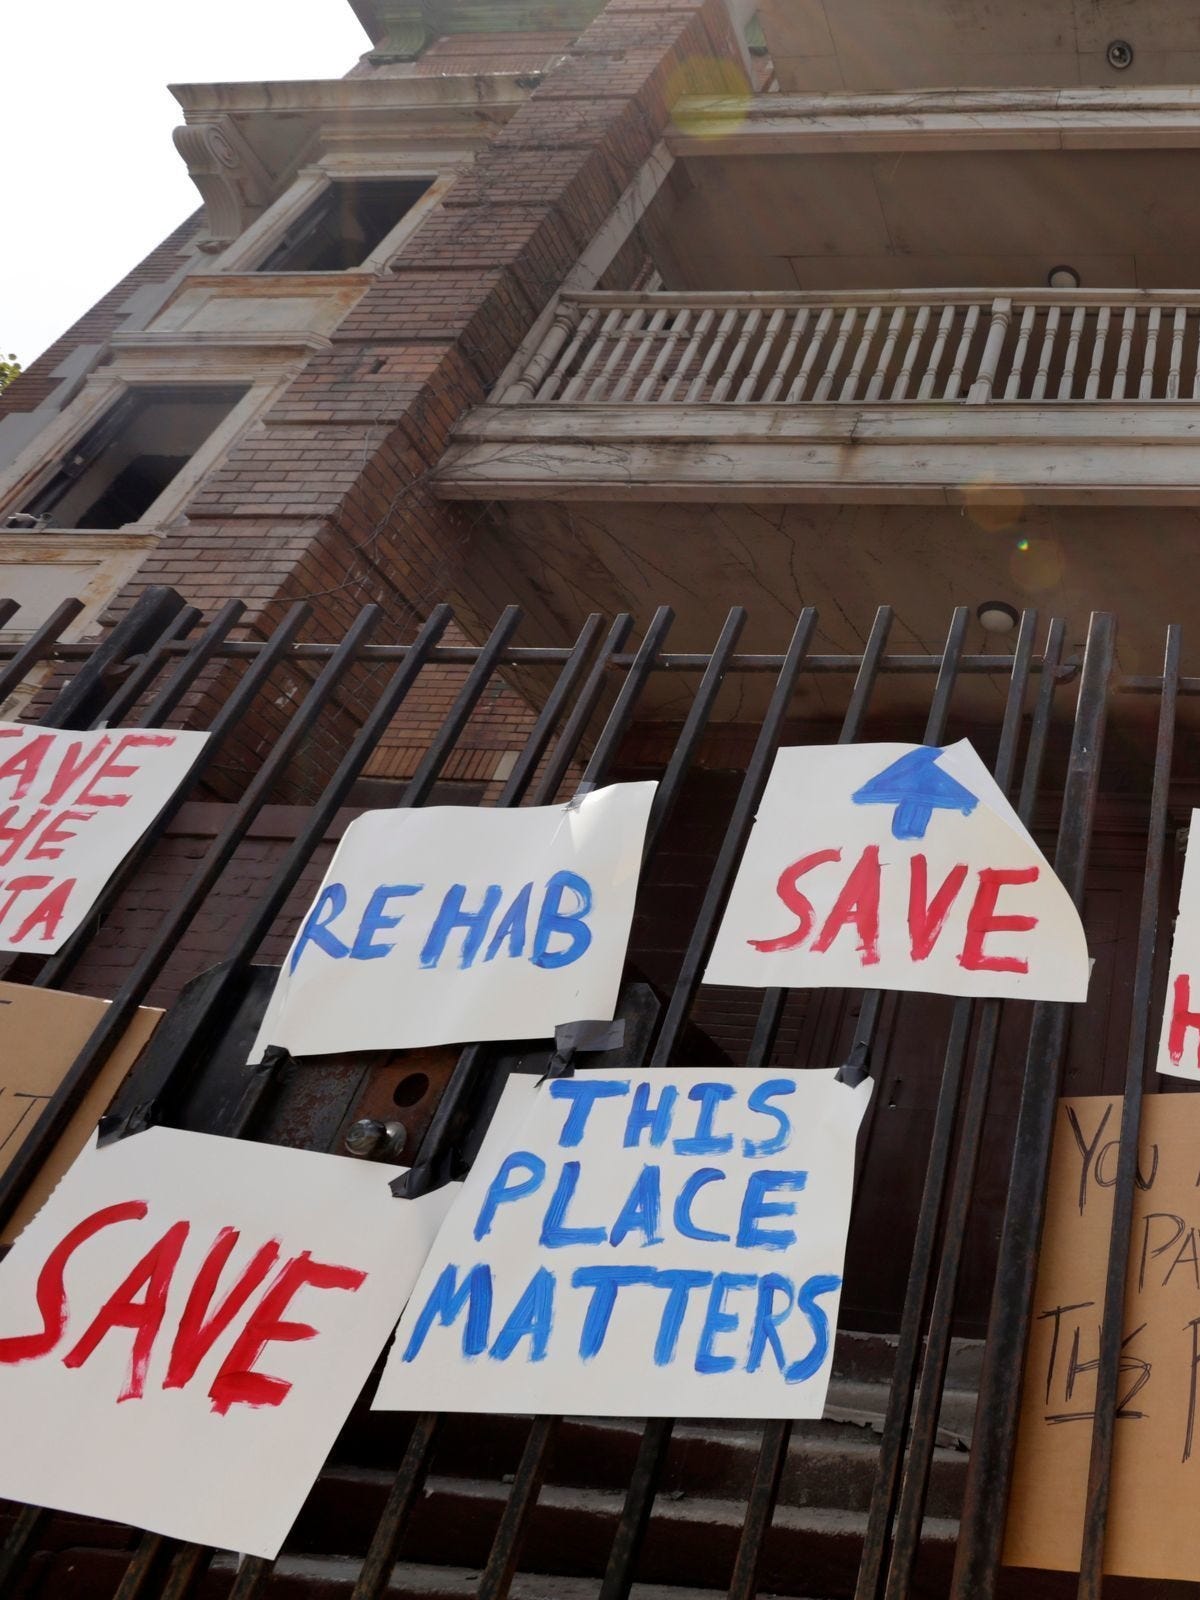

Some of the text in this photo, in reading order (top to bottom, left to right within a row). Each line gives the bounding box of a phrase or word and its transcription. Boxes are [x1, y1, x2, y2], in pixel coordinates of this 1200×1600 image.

[0, 728, 175, 807] AVE
[0, 805, 98, 866] HE
[289, 869, 593, 977] REHAB
[747, 845, 1040, 974] SAVE
[550, 1077, 797, 1159] THIS
[473, 1150, 808, 1251] PLACE
[0, 1200, 369, 1415] SAVE
[402, 1263, 843, 1384] MATTERS
[1037, 1301, 1152, 1418] THS
